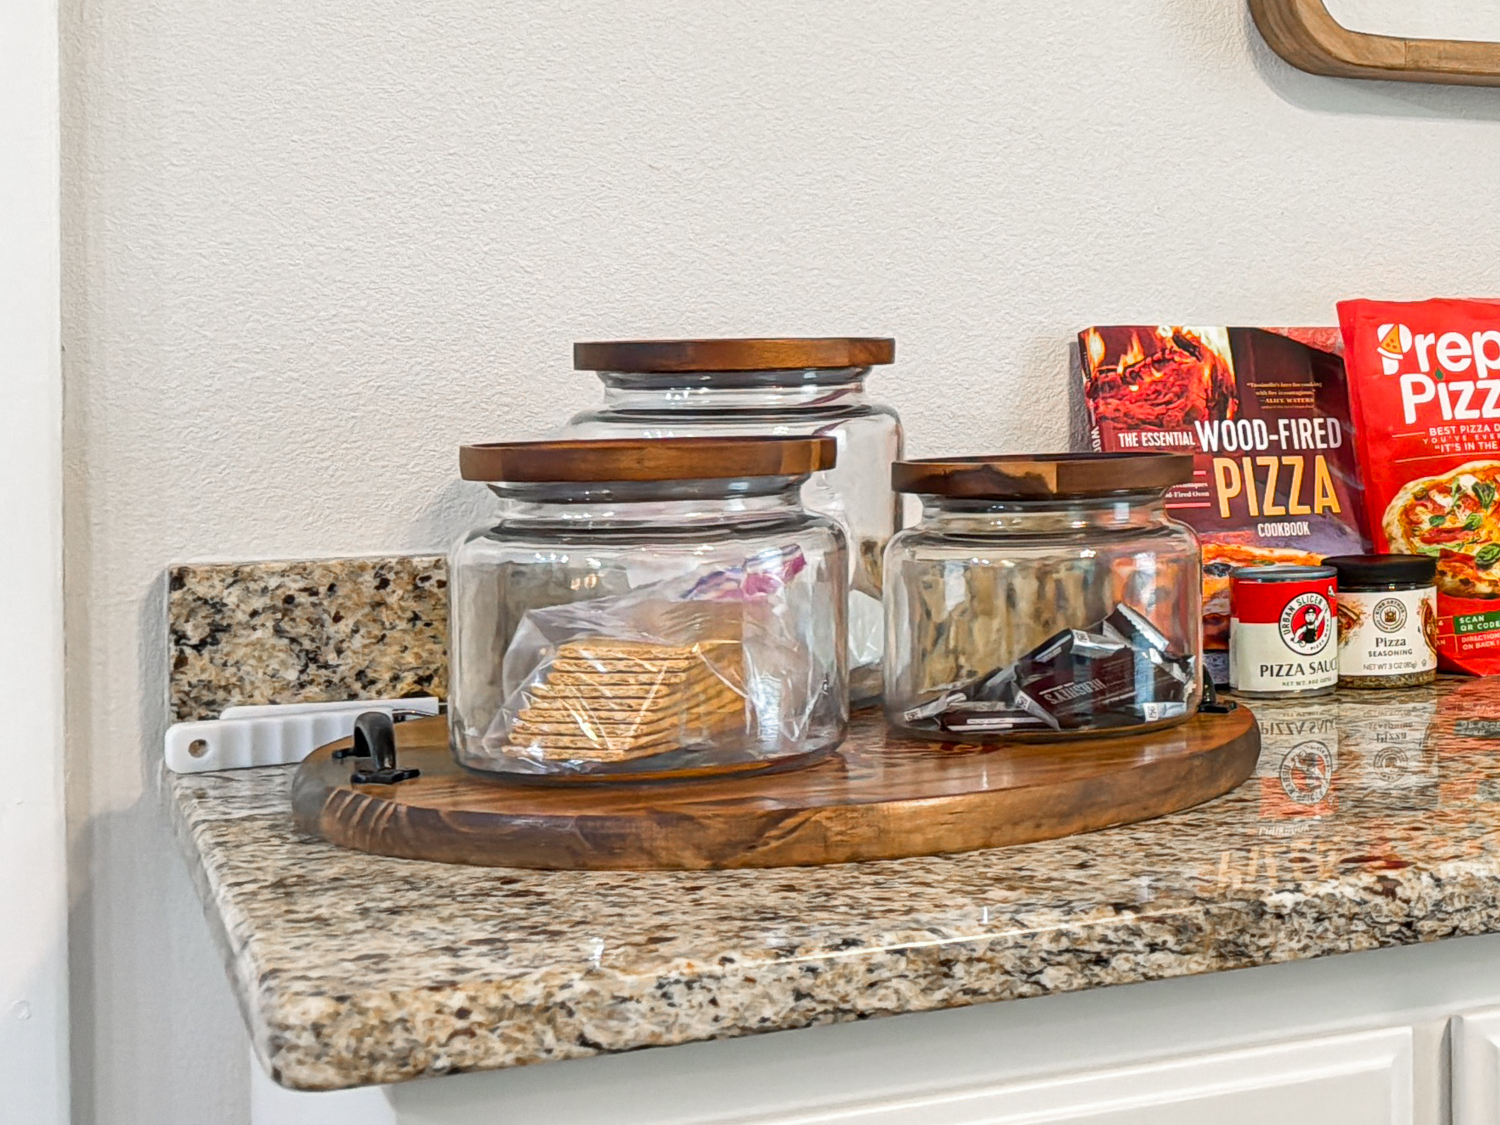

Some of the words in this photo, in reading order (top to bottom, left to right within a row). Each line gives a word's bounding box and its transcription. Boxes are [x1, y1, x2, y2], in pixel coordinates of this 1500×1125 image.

[1118, 432, 1139, 448] THE
[1142, 430, 1196, 448] ESSENTIAL
[1194, 417, 1343, 453] WOOD-FIRED
[1429, 426, 1457, 436] BEST
[1460, 424, 1491, 434] PIZZA
[1423, 434, 1467, 444] YOU'VE
[1464, 442, 1475, 451] IN
[1478, 441, 1498, 450] THE
[1212, 454, 1342, 519] PIZZA
[1257, 521, 1311, 537] COOKBOOK
[1281, 605, 1296, 635] URBAN
[1295, 595, 1323, 607] SLICER
[1459, 615, 1485, 624] SCAN
[1460, 624, 1474, 632] QR
[1477, 620, 1500, 630] CODE
[1375, 637, 1406, 648] Pizza
[1368, 648, 1413, 658] SEASONING
[1260, 663, 1305, 678] PIZZA
[1043, 678, 1107, 706] HERSHEY'S
